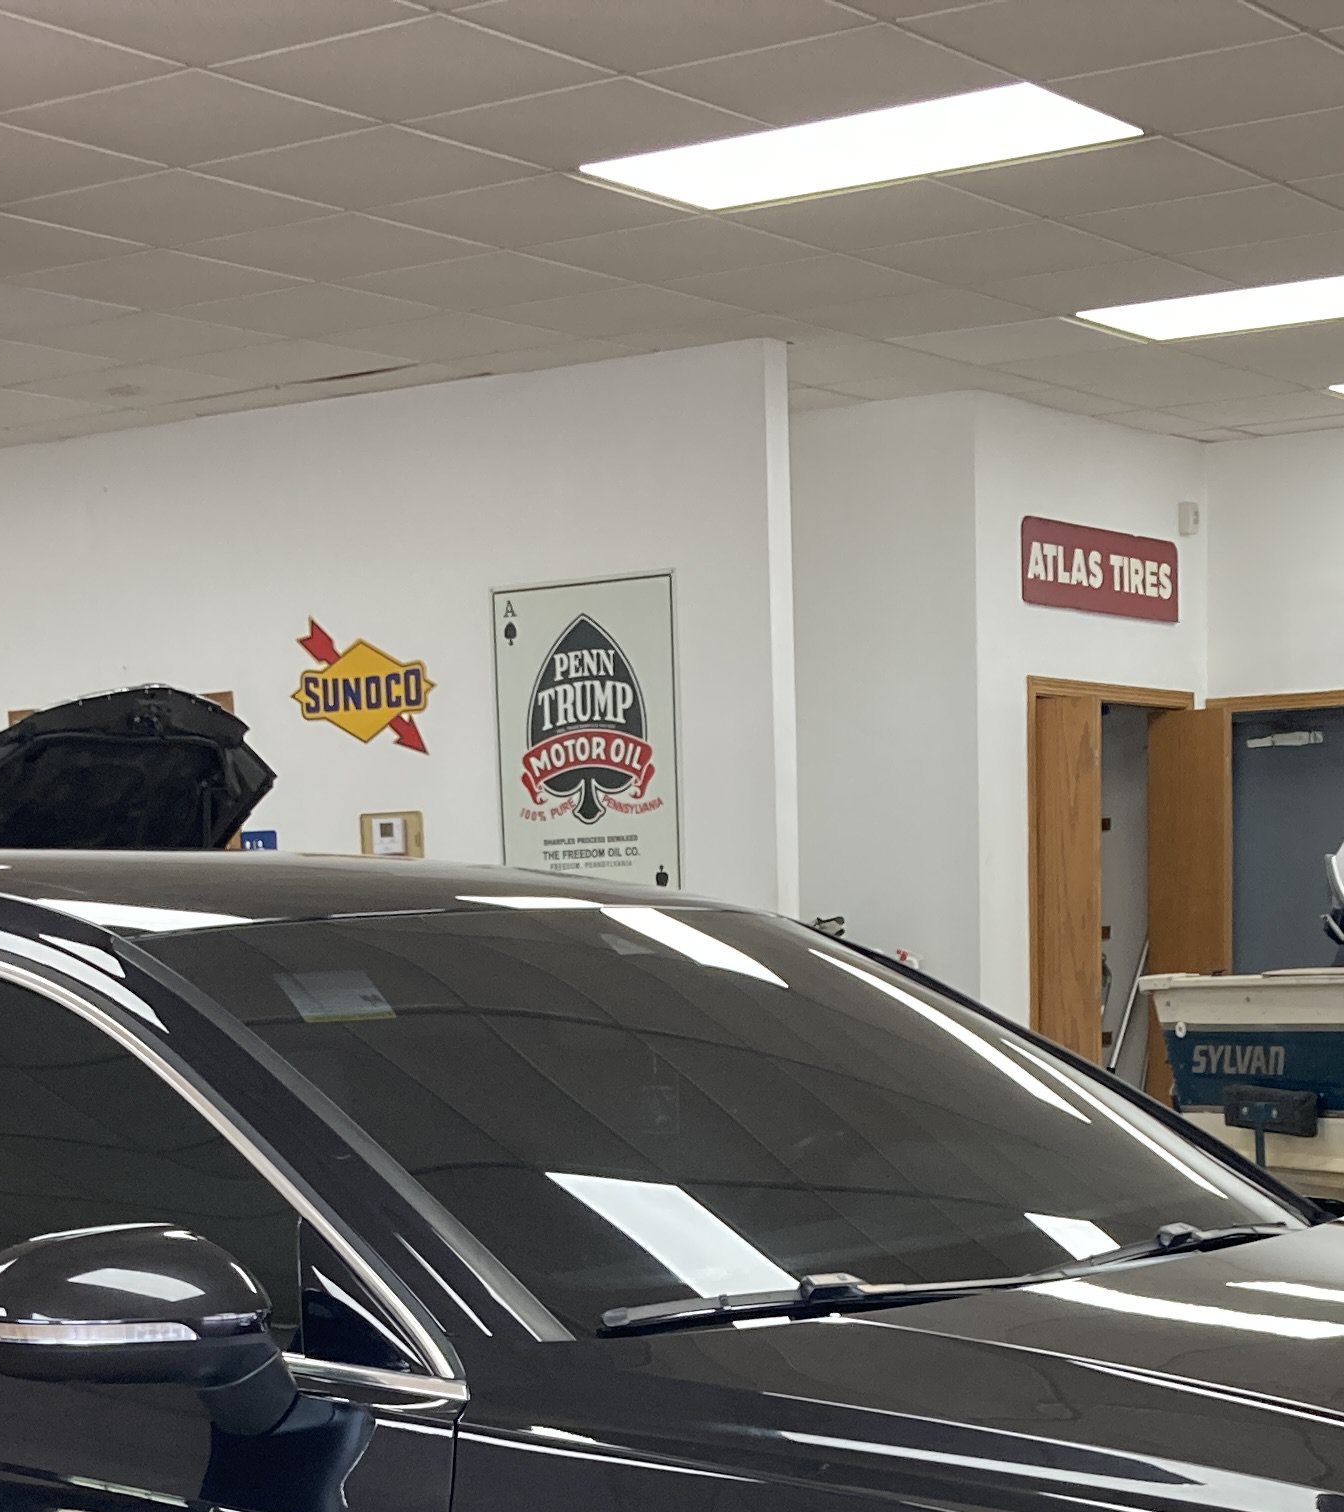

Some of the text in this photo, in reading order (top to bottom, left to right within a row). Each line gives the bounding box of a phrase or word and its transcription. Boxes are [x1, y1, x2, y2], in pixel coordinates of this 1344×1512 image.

[1027, 541, 1173, 600] ATLAS TIRES
[503, 600, 517, 618] A
[553, 649, 615, 681] PENN
[304, 668, 424, 714] SUNOCO
[537, 680, 634, 731] TRUMP
[528, 736, 642, 777] MOTOR OIL
[520, 793, 665, 822] 100% PURE PENNSYLVANIA
[542, 846, 641, 861] THE FREEDOM OIL CO.
[1191, 1044, 1286, 1076] SYLVAN
